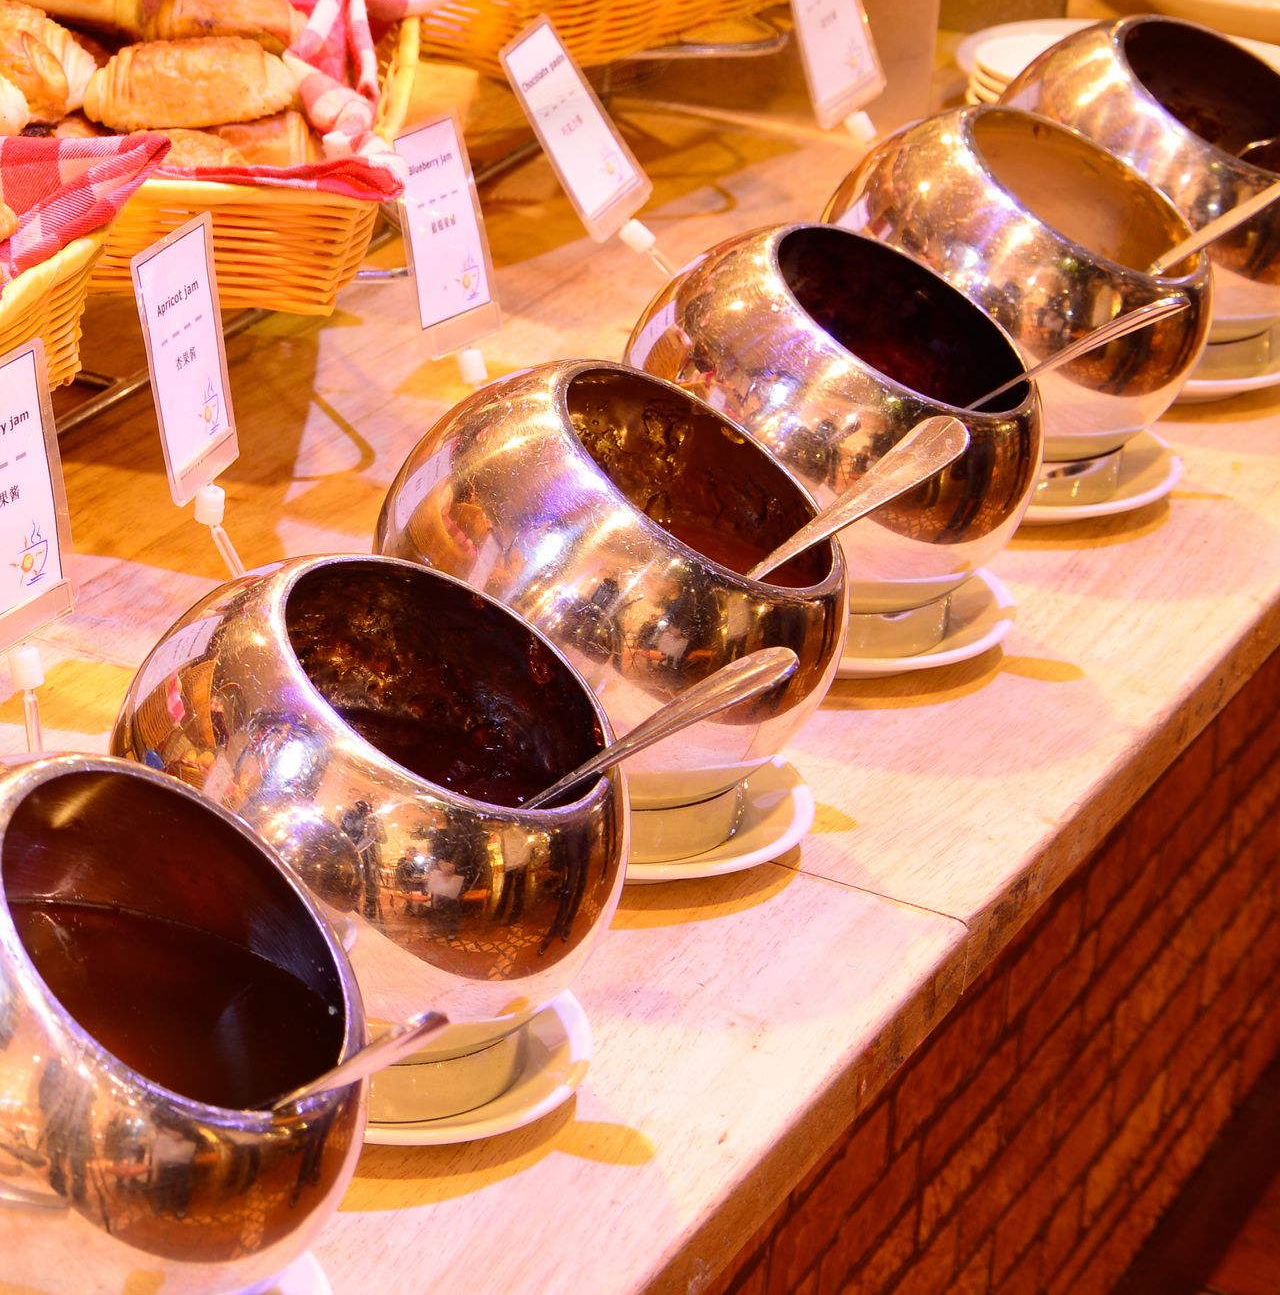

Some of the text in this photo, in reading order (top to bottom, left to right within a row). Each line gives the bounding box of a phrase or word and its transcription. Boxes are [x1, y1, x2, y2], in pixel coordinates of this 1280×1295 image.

[408, 158, 439, 176] Blueberry
[157, 280, 199, 318] Apricot jam
[9, 410, 30, 431] jam
